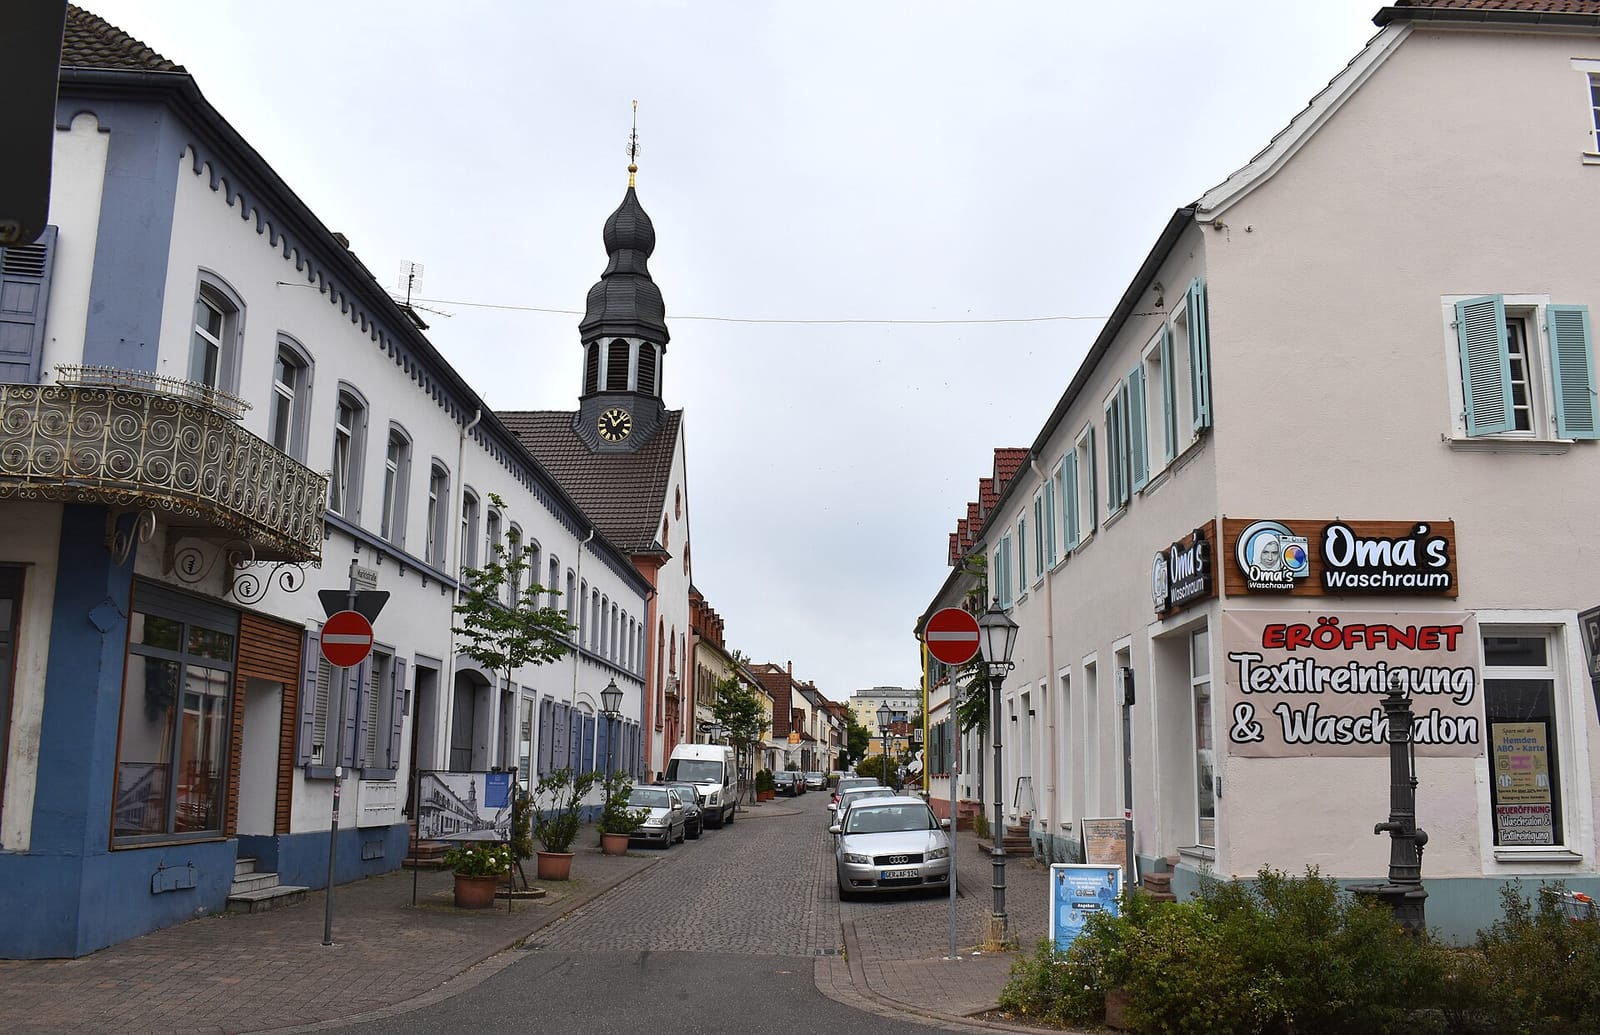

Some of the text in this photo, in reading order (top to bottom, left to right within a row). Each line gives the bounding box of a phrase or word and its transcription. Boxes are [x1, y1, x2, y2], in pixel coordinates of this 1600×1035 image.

[1325, 525, 1447, 567] Oma's
[1170, 532, 1203, 584] Oma's
[1250, 565, 1294, 582] Oma's
[1326, 570, 1449, 588] Waschraum
[1170, 577, 1204, 604] Waschraum
[1249, 581, 1294, 589] Waschraum
[1262, 617, 1463, 651] ERÖFFNET
[1228, 652, 1478, 704] Textilreinigung
[1230, 701, 1479, 744] & Waschalon
[1497, 805, 1550, 814] NEUERÖFFNUNG
[1501, 814, 1550, 827] Waschsalon &
[1499, 829, 1549, 843] Textilreinigung
